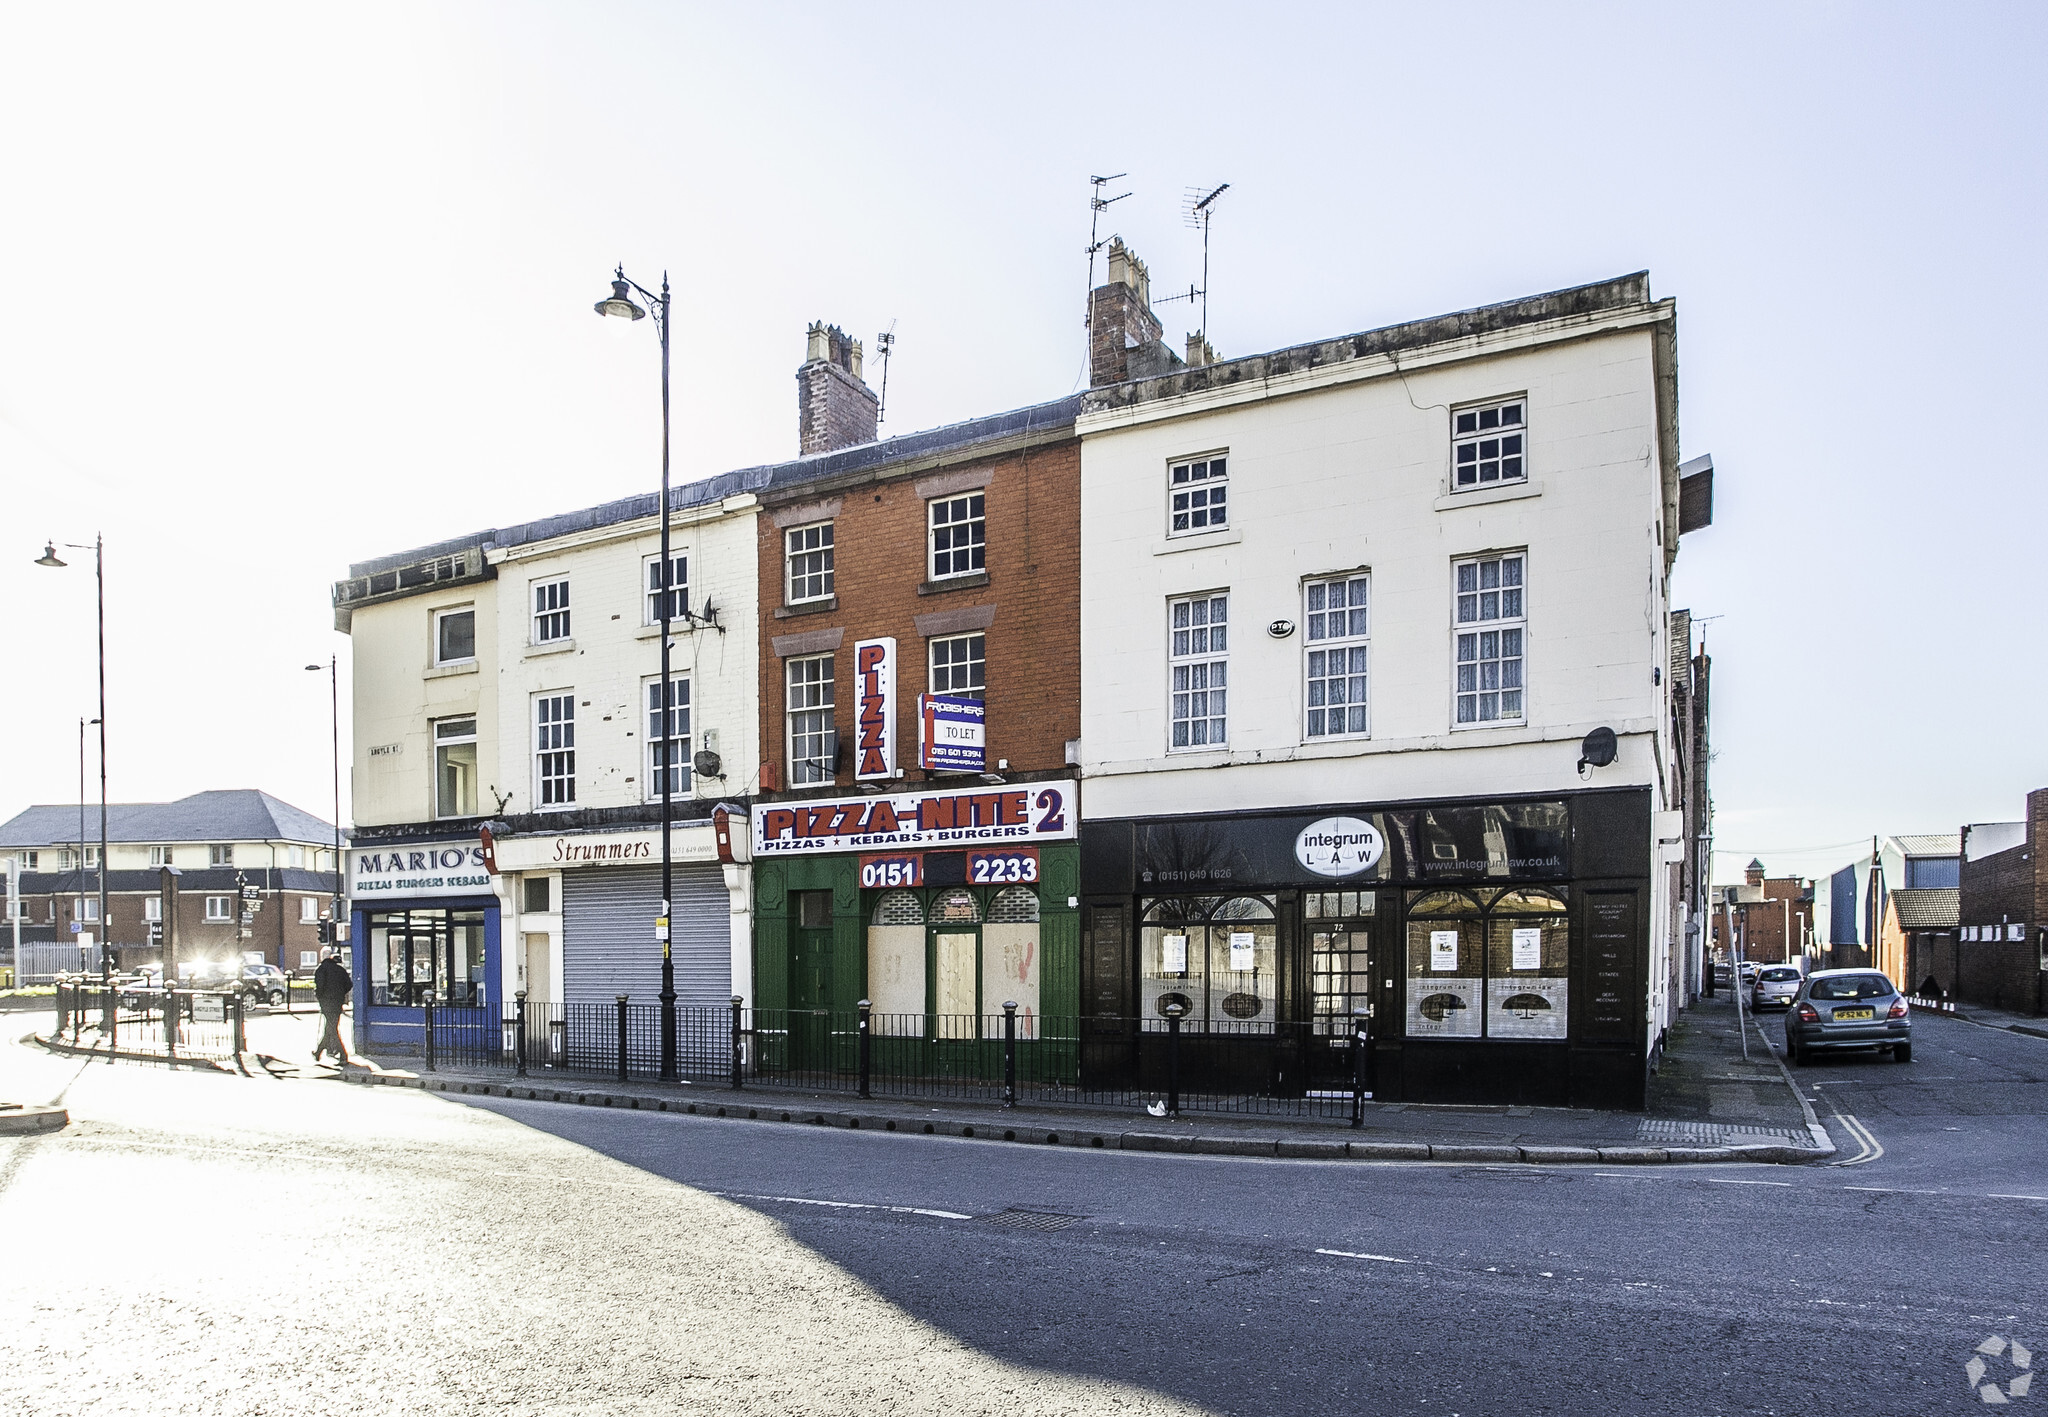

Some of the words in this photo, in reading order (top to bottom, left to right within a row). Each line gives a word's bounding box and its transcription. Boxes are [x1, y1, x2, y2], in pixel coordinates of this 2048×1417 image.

[858, 644, 888, 775] PIZZA
[926, 701, 985, 717] FROBISHERS
[946, 727, 957, 738] TO
[960, 728, 975, 739] LET
[931, 747, 946, 755] 0151
[948, 748, 960, 757] 601
[962, 750, 981, 758] 9394
[763, 790, 1029, 841] PIZZA-NITE
[1036, 788, 1065, 833] 2
[764, 839, 826, 851] PIZZAS
[850, 833, 923, 845] KEBABS
[938, 826, 1030, 840] BURGERS
[1304, 832, 1373, 848] integrum
[553, 838, 651, 861] Strummers
[357, 846, 485, 874] MARIO'S
[1424, 855, 1561, 871] www.integrumlaw.co.uk
[862, 862, 914, 887] 0151
[974, 857, 1037, 883] 2233
[1158, 871, 1188, 882] (0151)
[1189, 870, 1207, 880] 649
[1209, 868, 1232, 879] 1626
[356, 881, 392, 890] PIZZAS
[396, 877, 444, 888] BURGERS
[447, 875, 491, 887] KEBABS
[1334, 923, 1344, 931] 72
